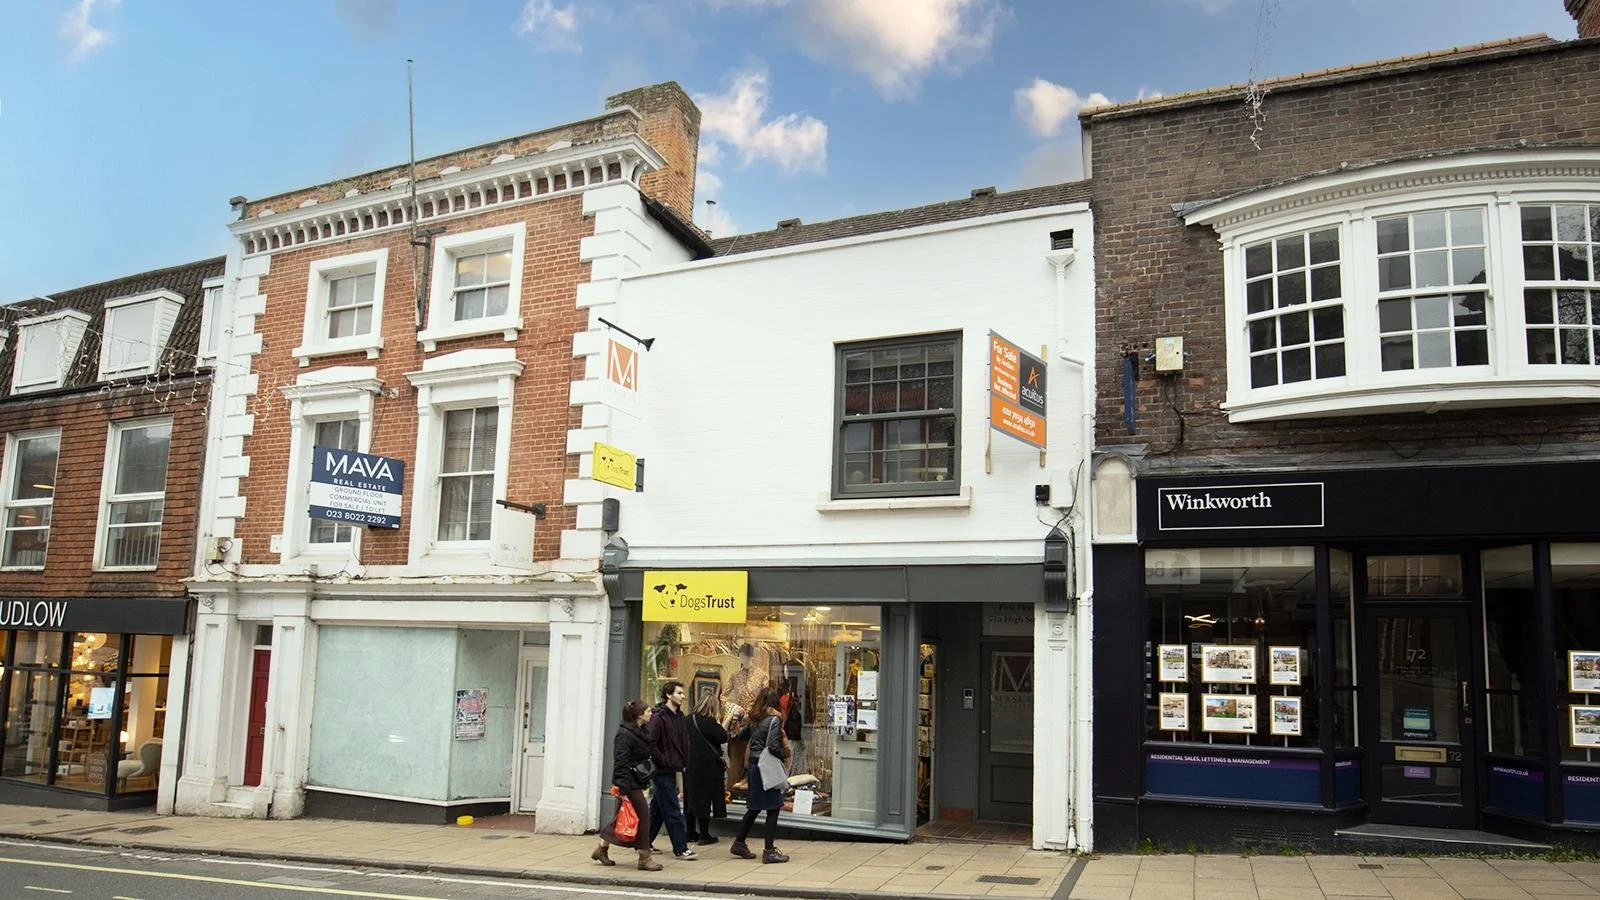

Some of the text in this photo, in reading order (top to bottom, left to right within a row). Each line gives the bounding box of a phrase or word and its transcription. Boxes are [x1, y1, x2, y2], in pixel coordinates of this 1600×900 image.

[993, 340, 1017, 364] For Sale
[1021, 385, 1044, 405] acuitus
[325, 451, 395, 482] MAVA
[333, 478, 386, 492] REAL ESTATE
[334, 486, 384, 499] GROUND FLOOR
[329, 493, 387, 507] COMMERCIAL UNIT
[1165, 491, 1273, 511] Winkworth
[344, 502, 359, 510] SALE
[365, 504, 373, 512] TO
[373, 506, 386, 514] LET
[326, 509, 387, 524] 023 8022 2292
[680, 594, 736, 611] DogsTrust
[1024, 615, 1034, 623] S
[1407, 648, 1427, 663] 72
